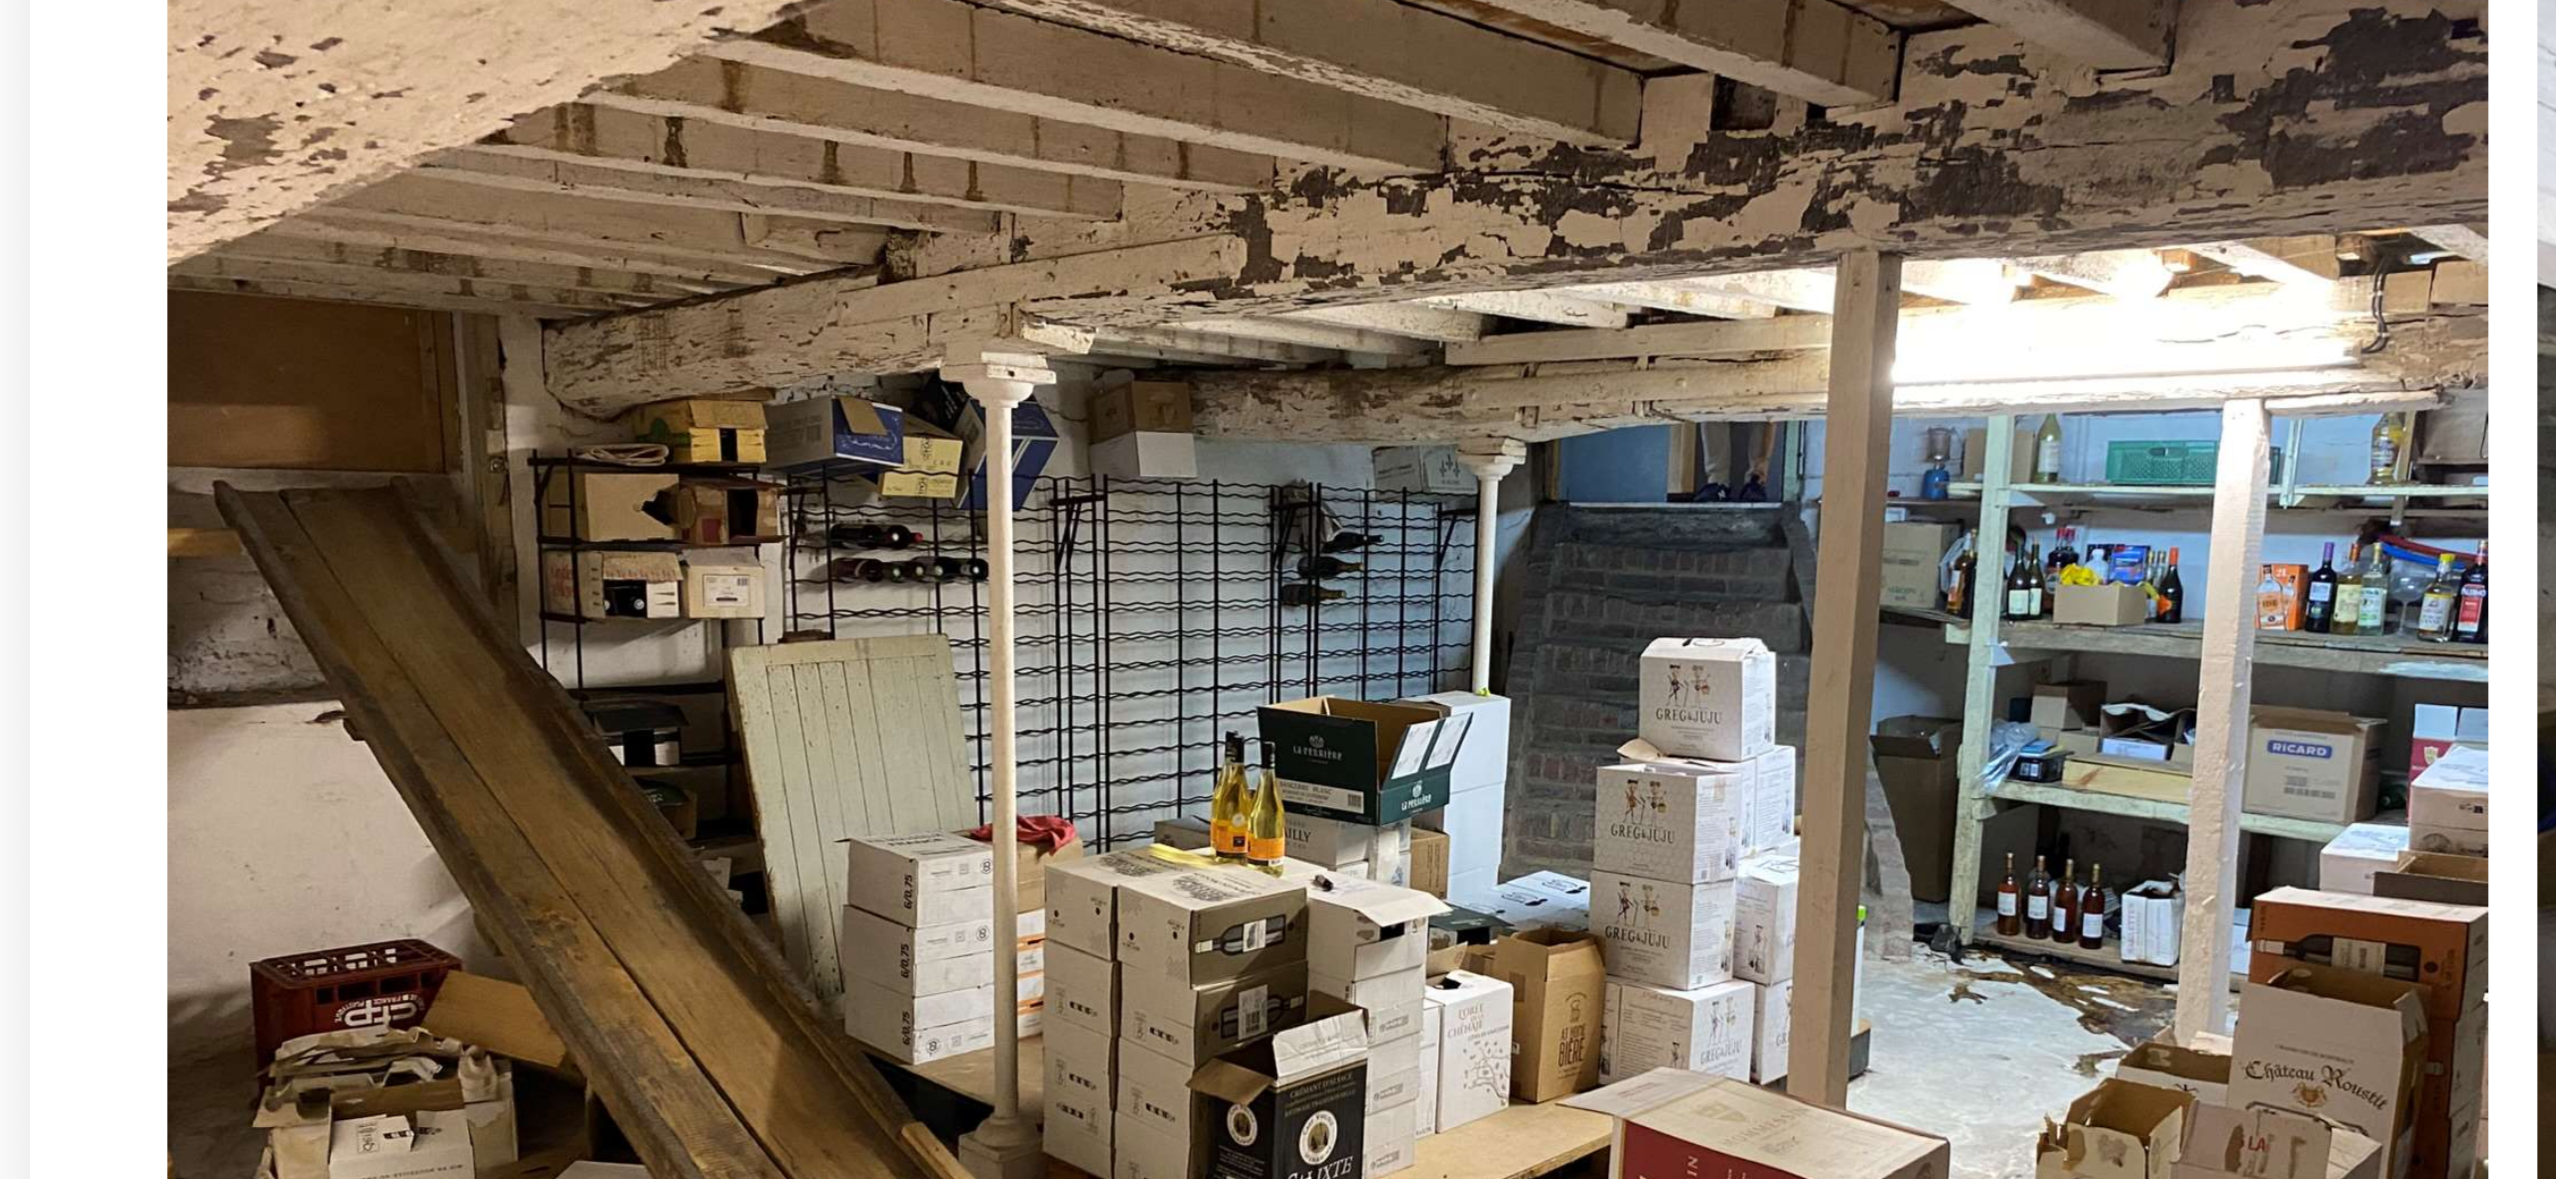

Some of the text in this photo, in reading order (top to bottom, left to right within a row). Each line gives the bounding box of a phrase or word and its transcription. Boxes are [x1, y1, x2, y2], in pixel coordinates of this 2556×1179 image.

[1655, 707, 1722, 725] GREG&JUJU
[2271, 742, 2328, 757] RICARD
[1610, 821, 1676, 845] GREG&JUJU
[1605, 925, 1671, 949] GREG&JUJU
[1558, 1036, 1585, 1067] BIÈRE
[2245, 1060, 2389, 1111] Château Roustit
